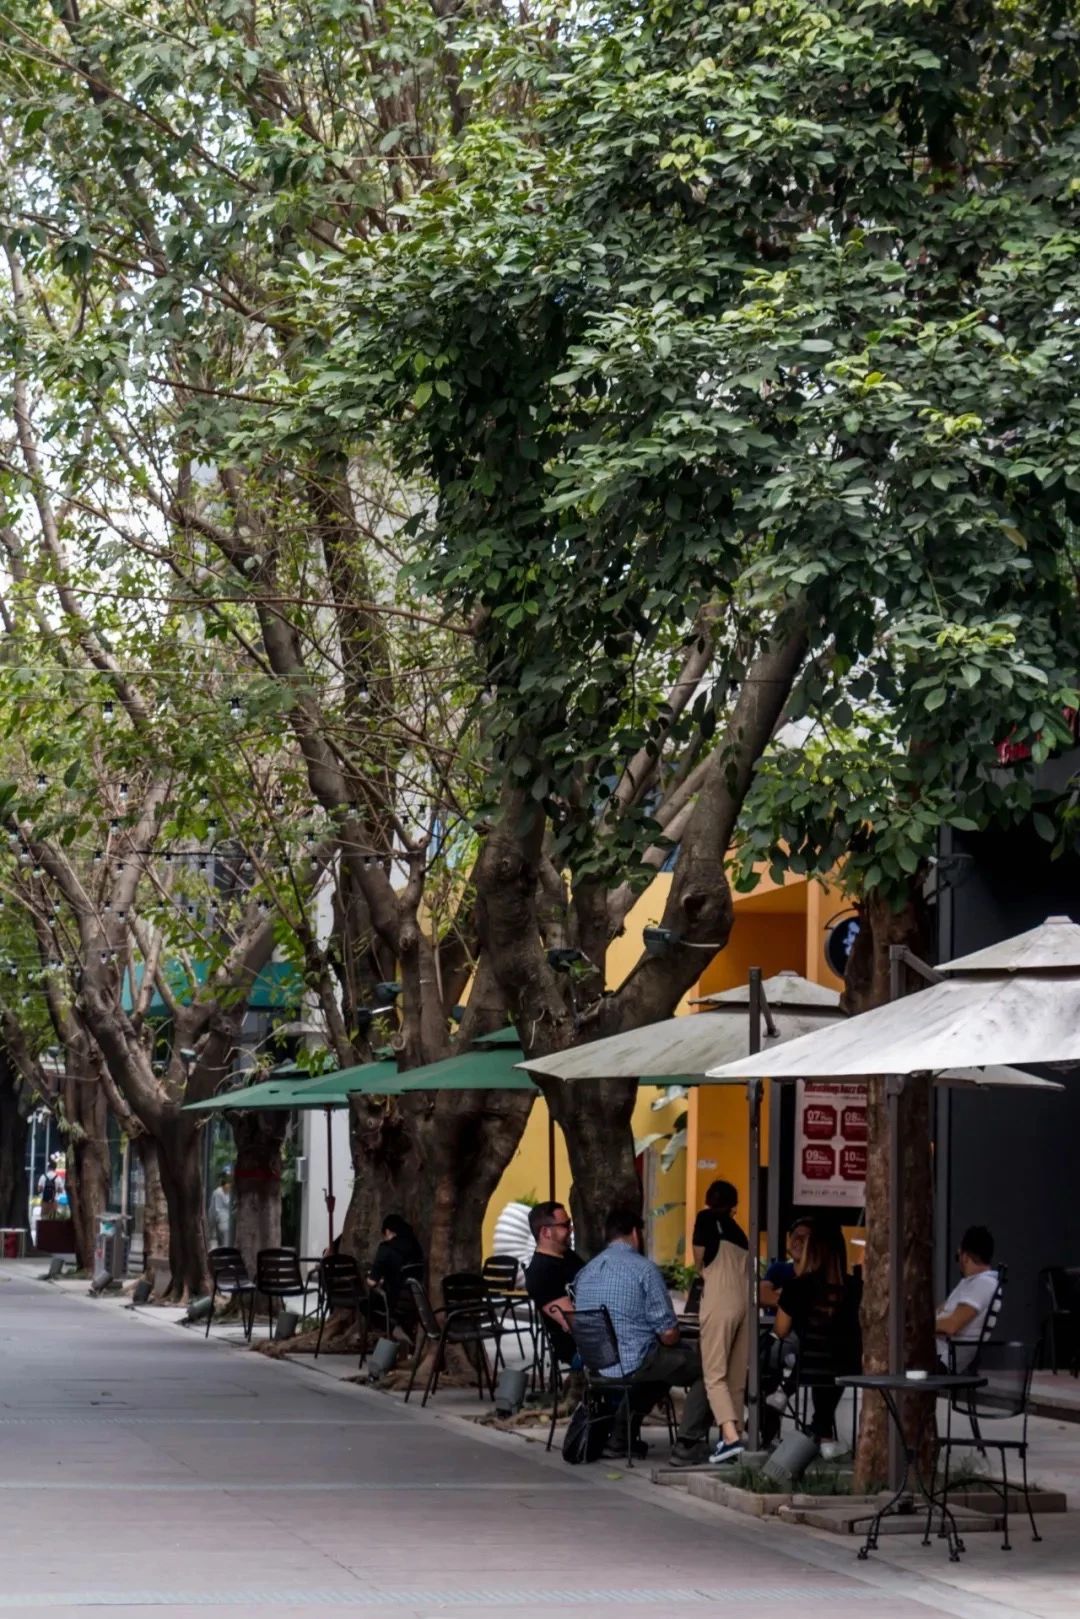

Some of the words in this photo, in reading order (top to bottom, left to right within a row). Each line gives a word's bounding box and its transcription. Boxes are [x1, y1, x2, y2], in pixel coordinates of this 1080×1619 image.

[807, 1110, 820, 1121] 07
[845, 1112, 857, 1122] 08
[806, 1149, 819, 1161] 09
[844, 1151, 856, 1162] 10
